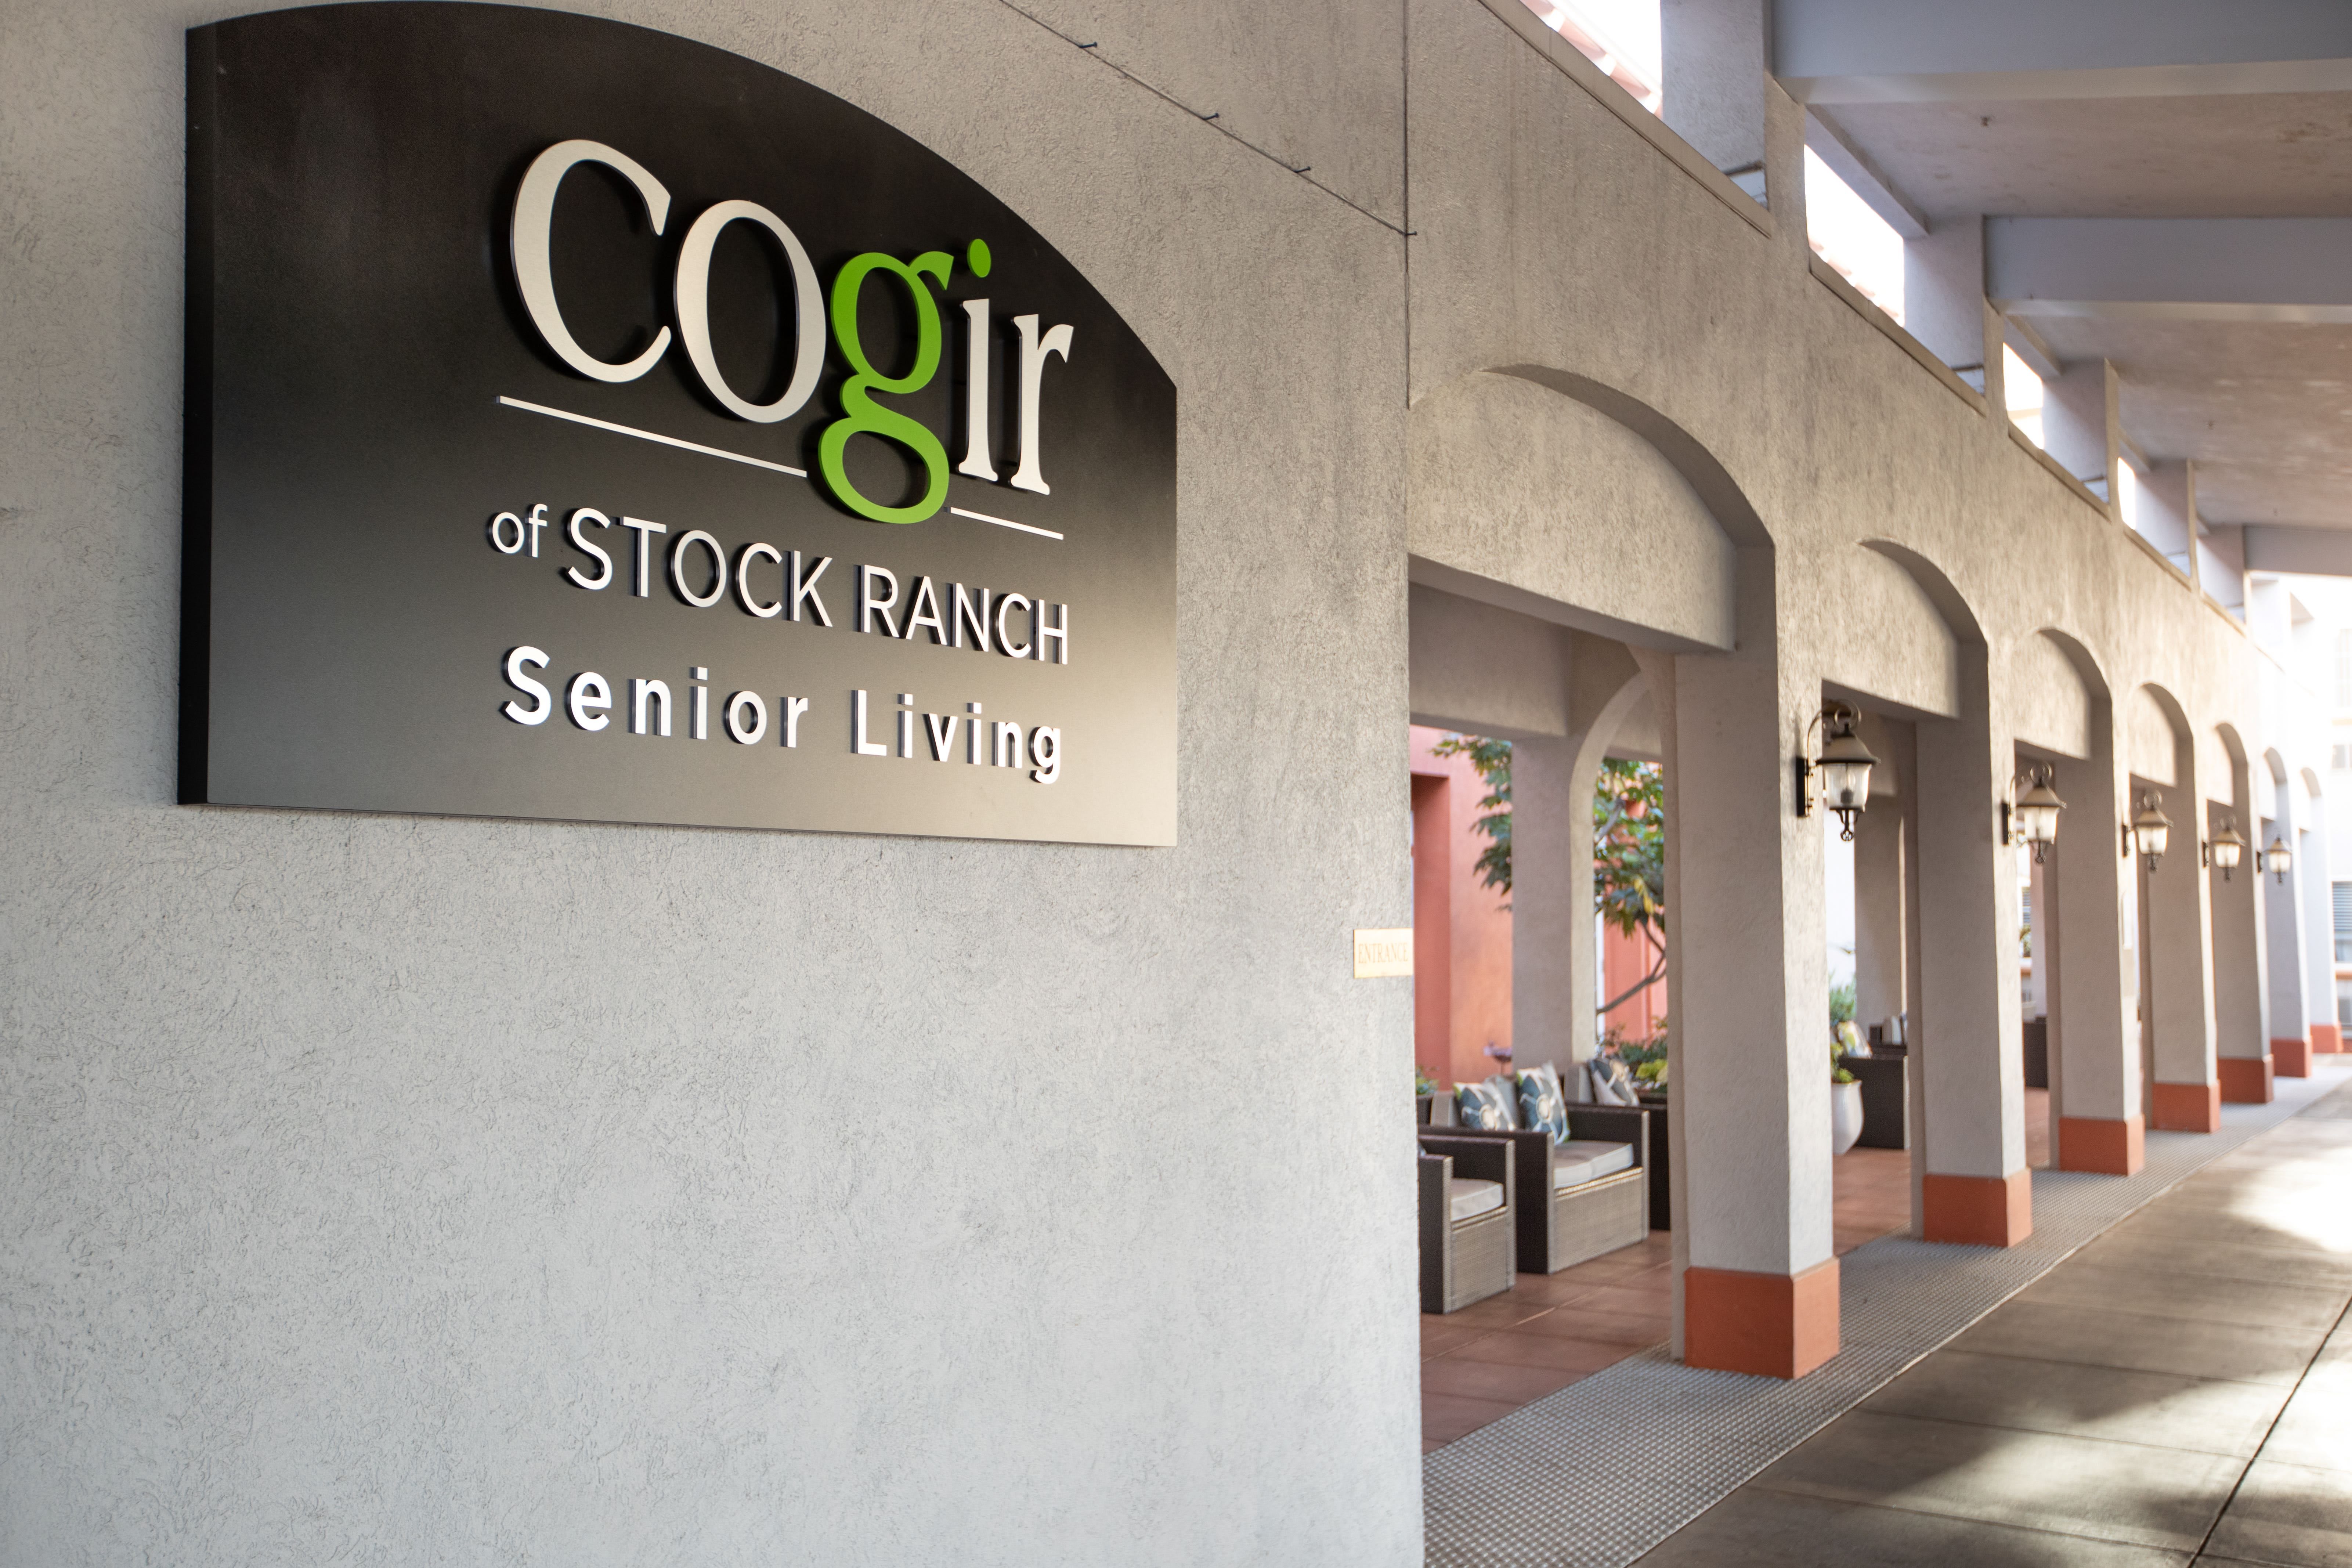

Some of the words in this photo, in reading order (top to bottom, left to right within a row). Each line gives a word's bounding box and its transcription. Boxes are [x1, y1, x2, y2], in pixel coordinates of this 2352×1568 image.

[489, 503, 548, 558] of
[566, 507, 832, 627] STOCK
[859, 564, 1068, 665] RANCH
[503, 646, 808, 748] Senior
[853, 689, 1061, 784] Living
[1358, 943, 1408, 964] ENTRANCE
